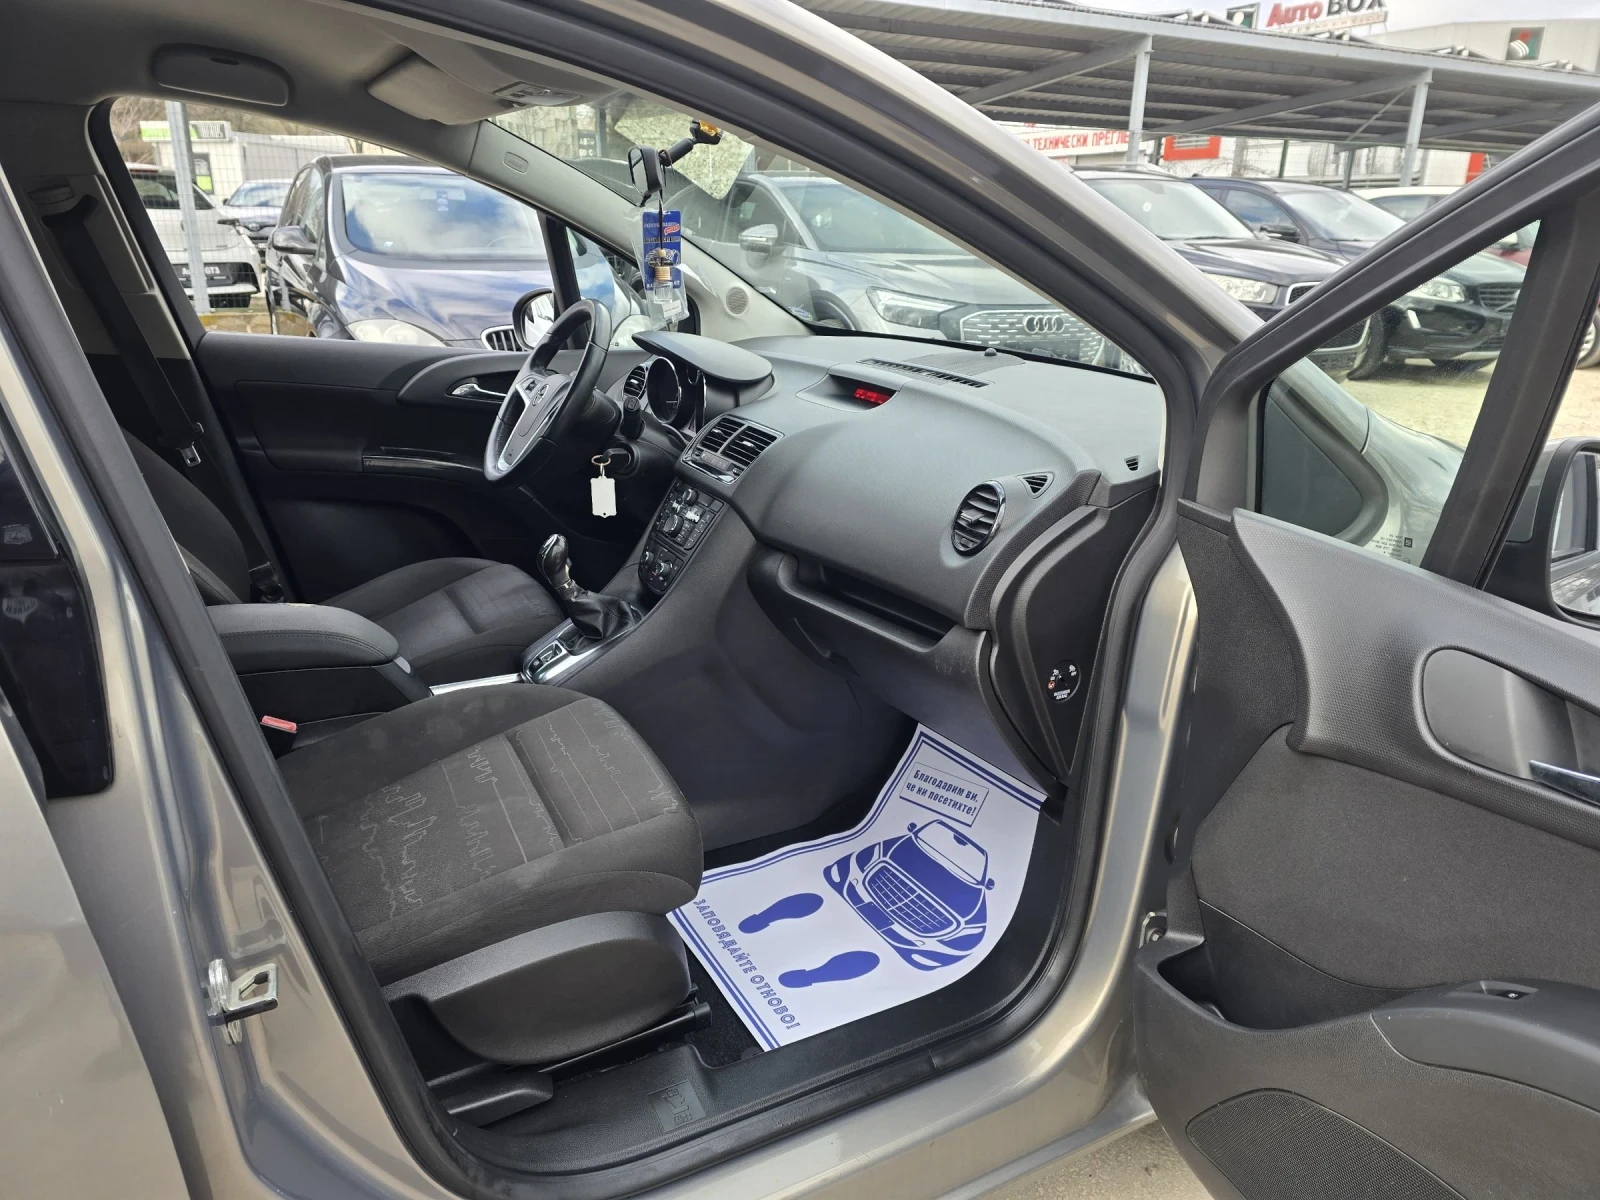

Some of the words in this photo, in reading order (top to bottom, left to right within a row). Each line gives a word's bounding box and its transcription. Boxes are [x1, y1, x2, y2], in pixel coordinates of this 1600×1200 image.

[1033, 133, 1088, 151] ТЕХНИЧЕСКИ
[1092, 130, 1130, 146] ПРЕГЛЕ
[906, 782, 916, 792] че
[916, 786, 928, 797] ни
[928, 791, 977, 816] посетихте!
[913, 769, 965, 796] Благодарим
[965, 790, 978, 803] ви,
[693, 898, 757, 974] ЗАПОВЯДАЙТЕ
[750, 974, 801, 1030] ОТНОВО!
